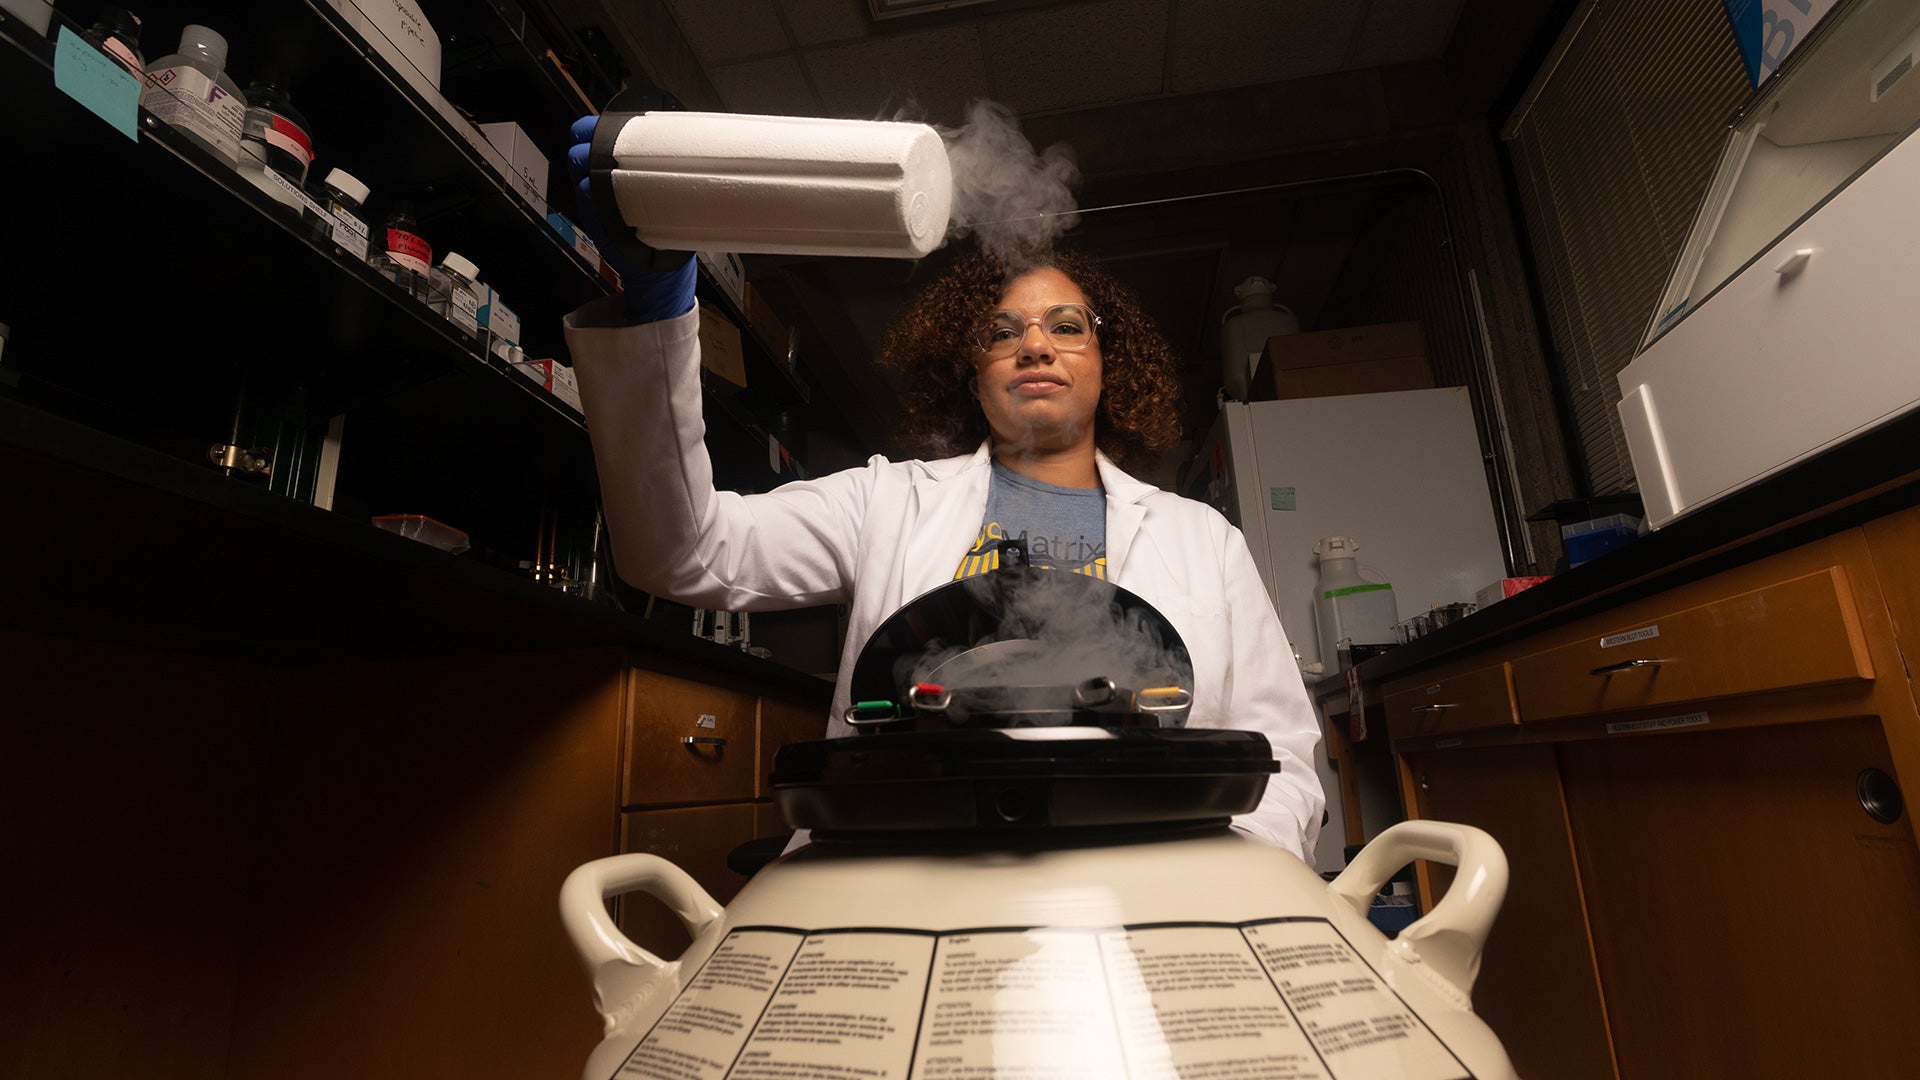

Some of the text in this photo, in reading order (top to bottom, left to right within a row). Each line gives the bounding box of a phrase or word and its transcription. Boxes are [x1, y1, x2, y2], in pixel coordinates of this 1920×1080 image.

[208, 85, 227, 103] F
[273, 173, 309, 205] SOLUTIONS
[309, 200, 327, 218] SHELF
[1605, 628, 1654, 646] WESTERN BLOT TOOLS
[1685, 714, 1703, 724] TOOLS
